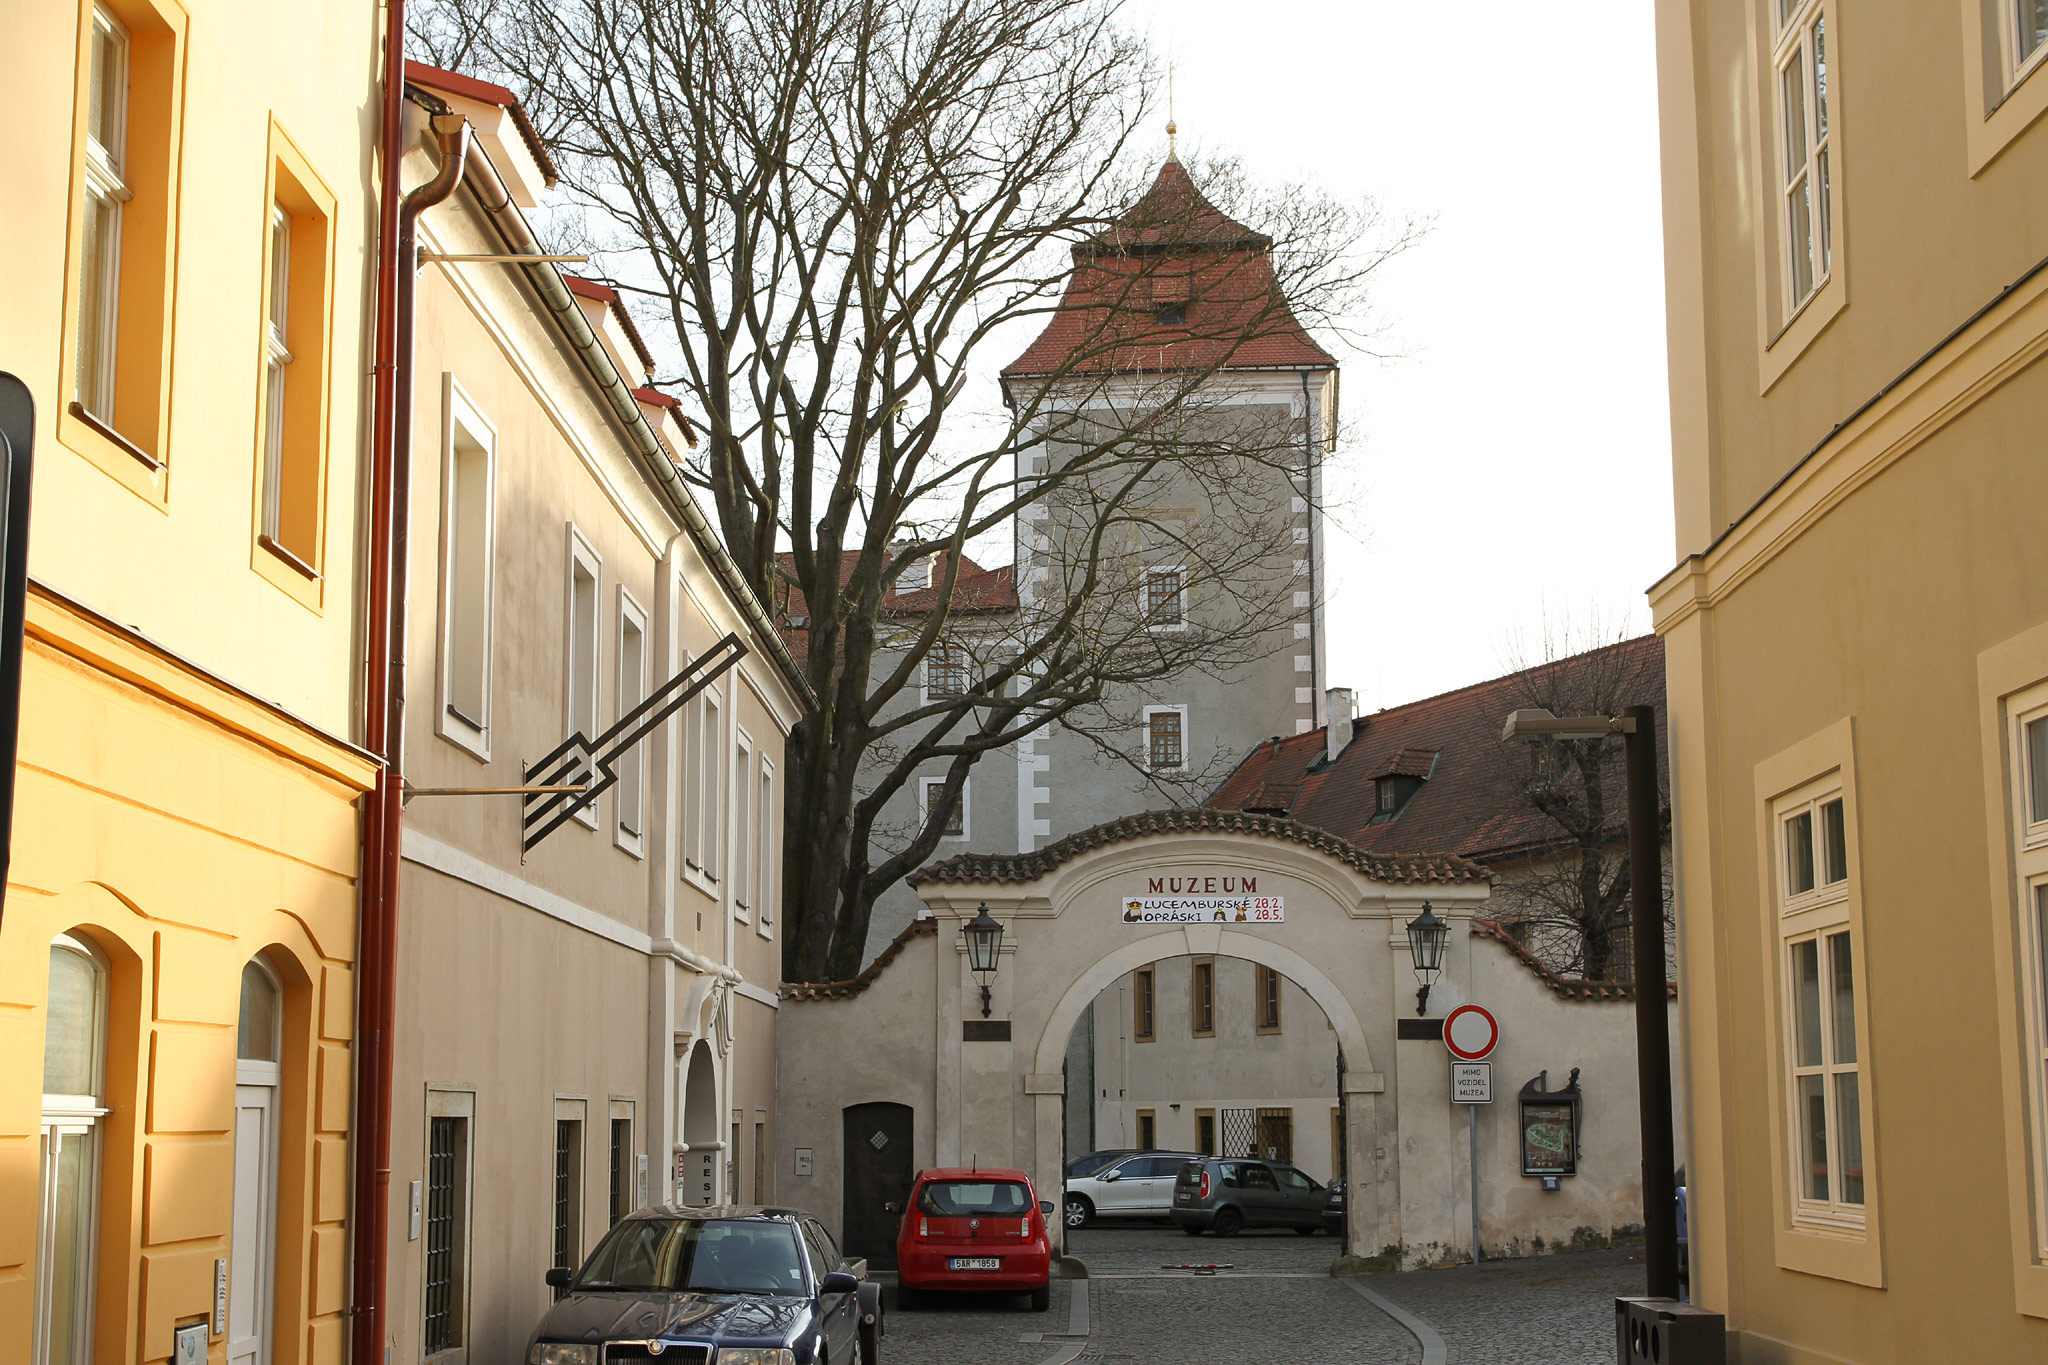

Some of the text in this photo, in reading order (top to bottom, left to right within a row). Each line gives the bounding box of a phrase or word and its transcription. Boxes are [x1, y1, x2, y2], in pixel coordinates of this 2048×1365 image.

[1148, 877, 1257, 893] MUZEUM
[1144, 897, 1252, 909] LUCEMBURSKÉ
[1254, 897, 1282, 909] 28.2.
[1144, 910, 1202, 922] OPRÁSKI
[1254, 909, 1282, 920] 28.5.
[956, 1259, 971, 1268] 5AR
